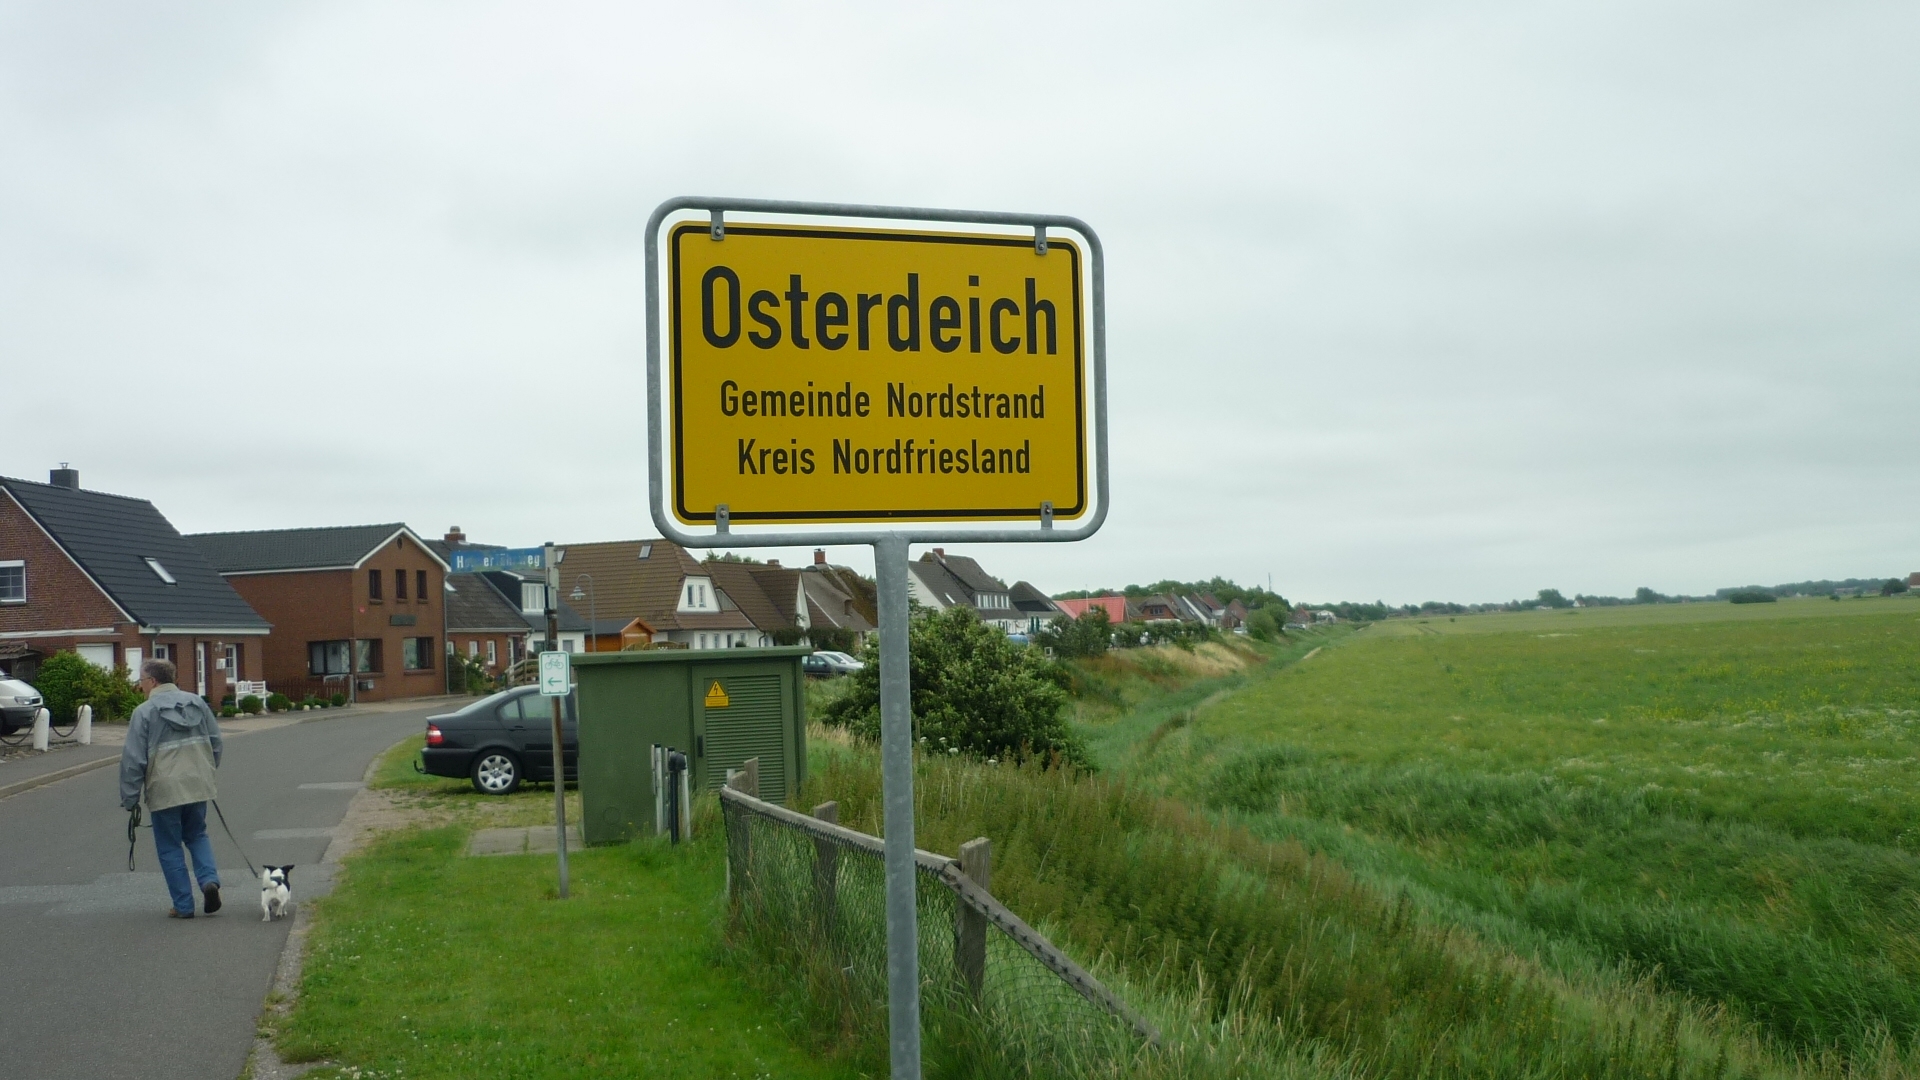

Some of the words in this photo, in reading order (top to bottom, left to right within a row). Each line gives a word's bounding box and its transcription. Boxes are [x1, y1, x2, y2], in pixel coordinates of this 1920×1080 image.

[701, 265, 1057, 355] Osterdeich
[720, 380, 870, 417] Gemeinde
[887, 382, 1045, 418] Nordstrand
[738, 438, 816, 474] Kreis
[833, 438, 1031, 474] Nordfriesland
